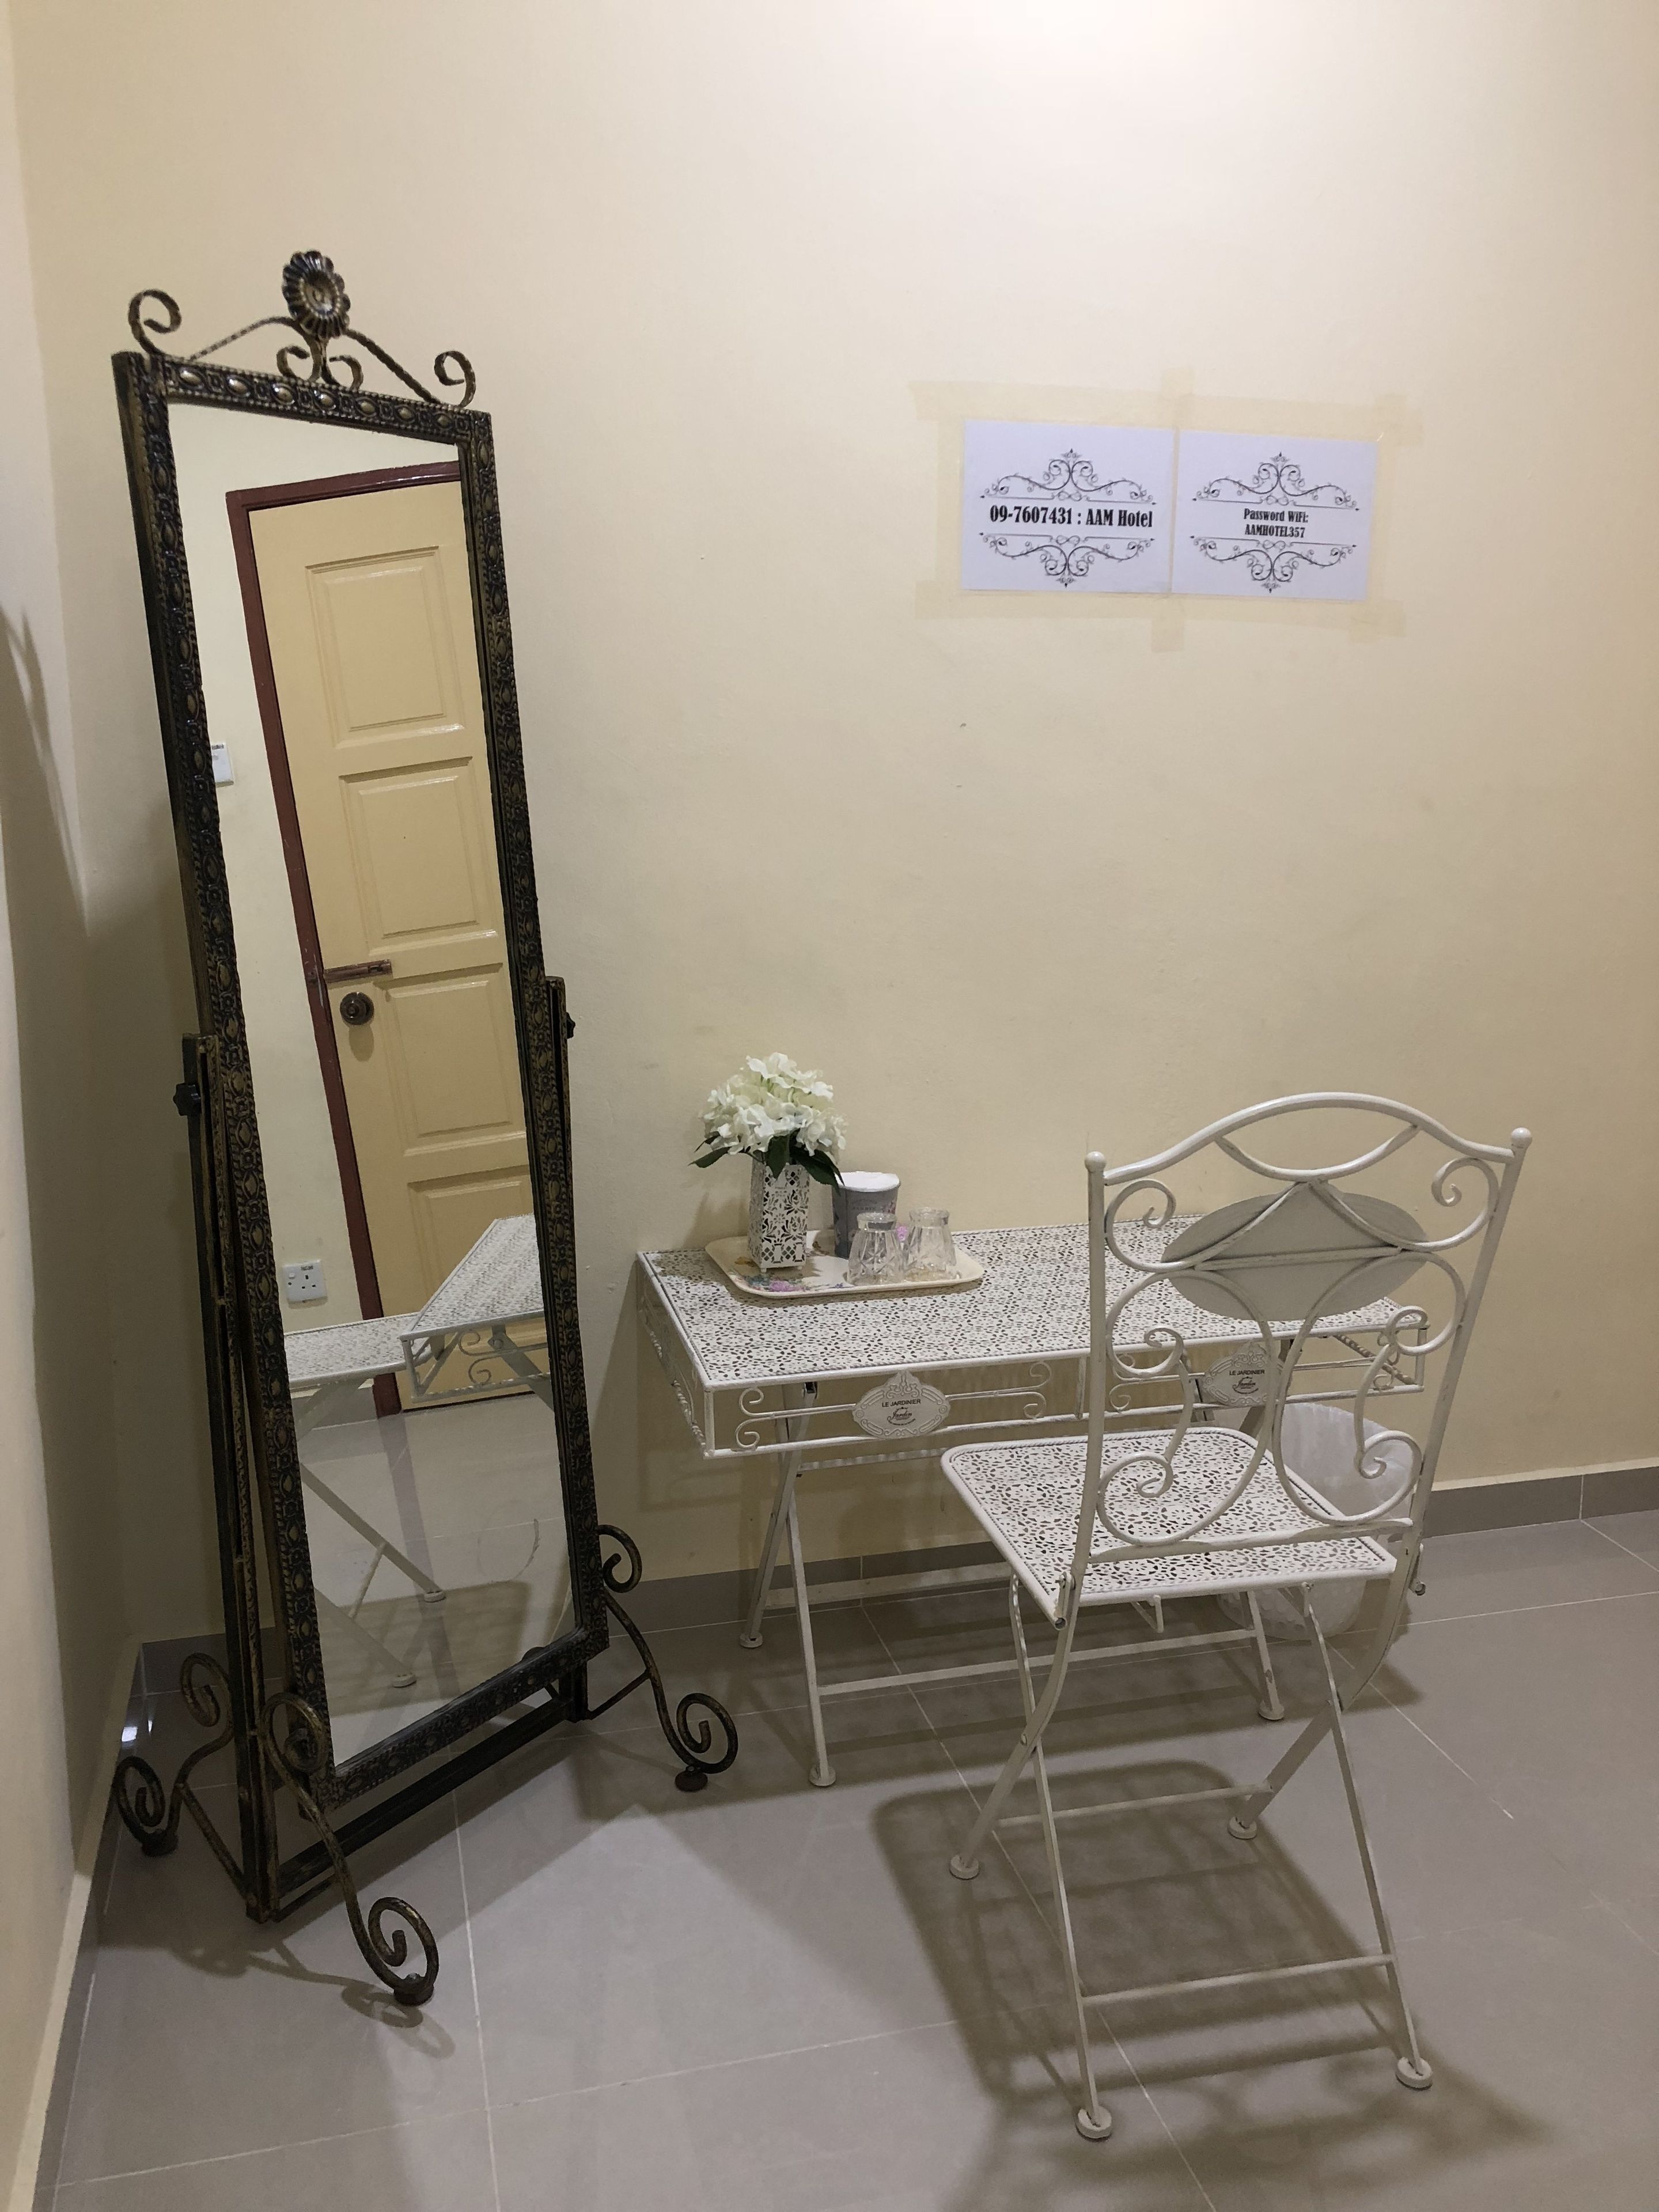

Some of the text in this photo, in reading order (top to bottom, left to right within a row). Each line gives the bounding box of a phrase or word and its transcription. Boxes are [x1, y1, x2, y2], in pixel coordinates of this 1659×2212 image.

[990, 505, 1072, 524] 09-7607431
[1085, 508, 1113, 526] AAM
[1118, 509, 1153, 527] Hotel
[1244, 508, 1285, 521] Password
[1245, 524, 1305, 538] AAMHOTEL357
[890, 1399, 921, 1407] JARDINIER
